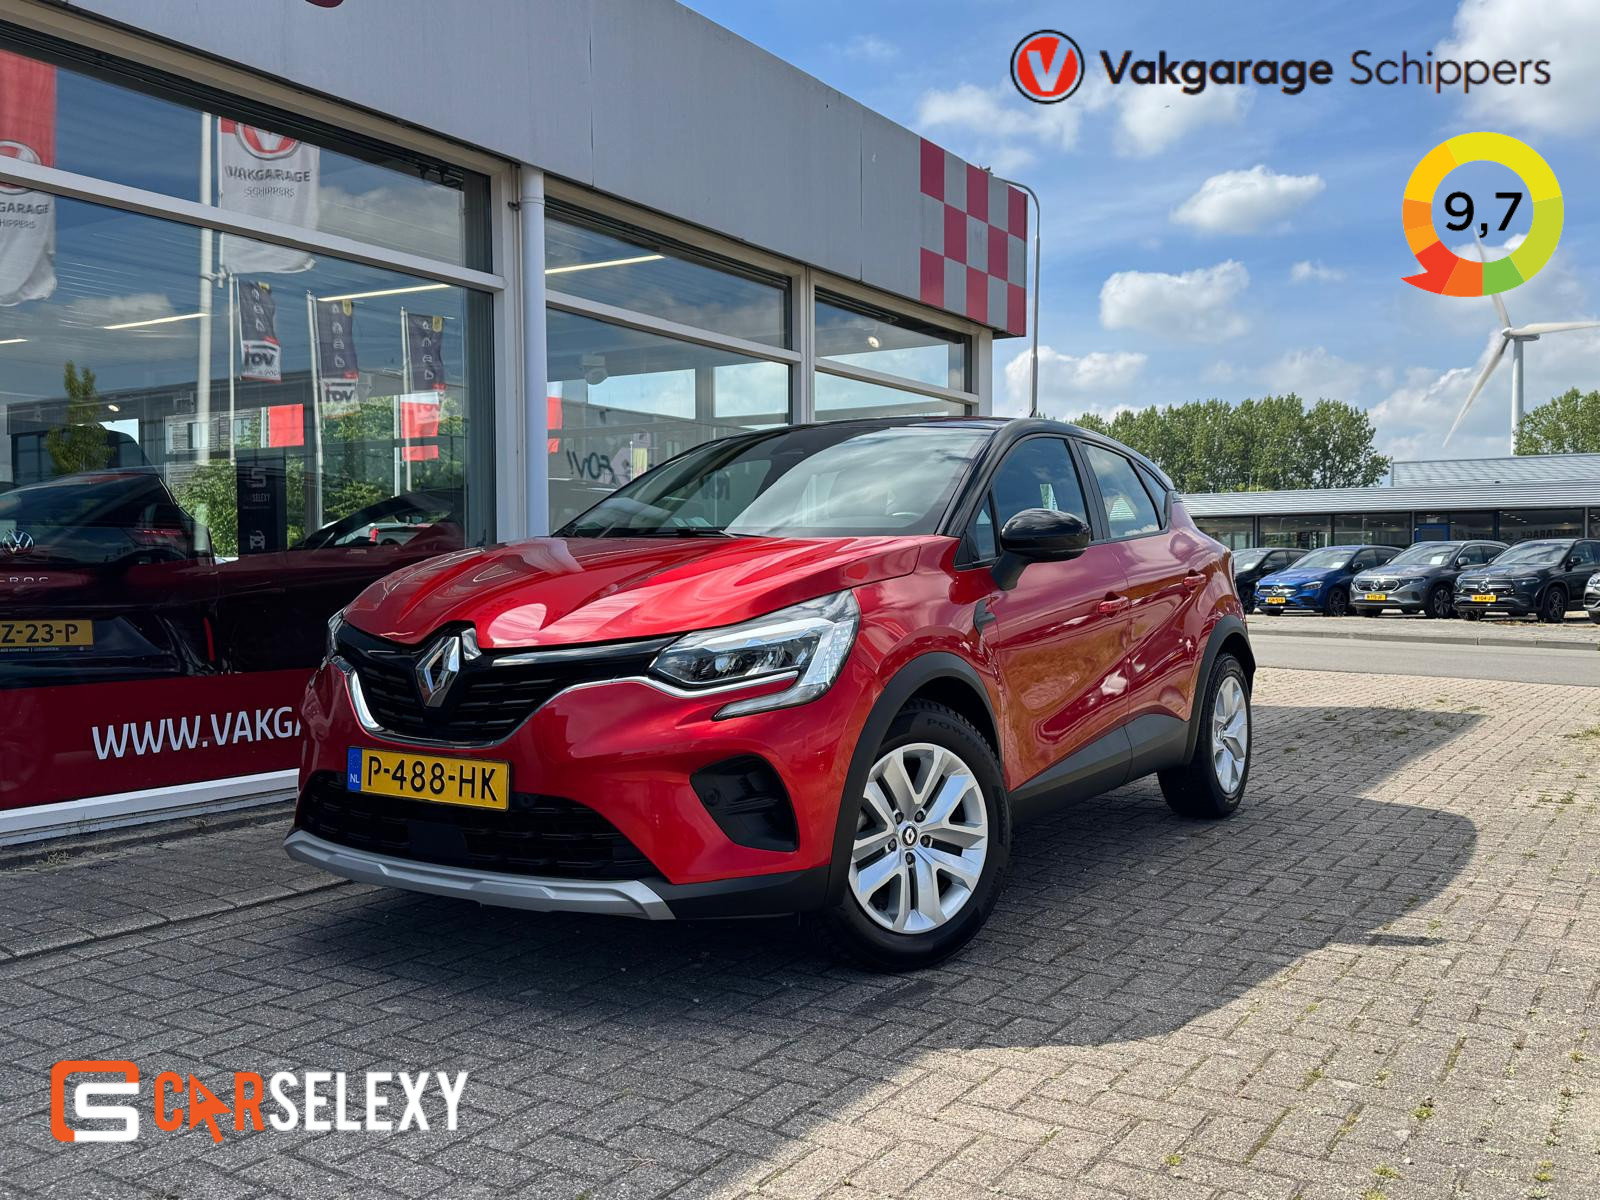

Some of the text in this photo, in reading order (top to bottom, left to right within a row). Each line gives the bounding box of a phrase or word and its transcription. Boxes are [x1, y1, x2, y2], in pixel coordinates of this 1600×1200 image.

[225, 165, 311, 182] VAKGARAGE
[1, 623, 79, 643] Z-23-P
[350, 773, 360, 784] NL
[367, 755, 498, 802] P-488-HK
